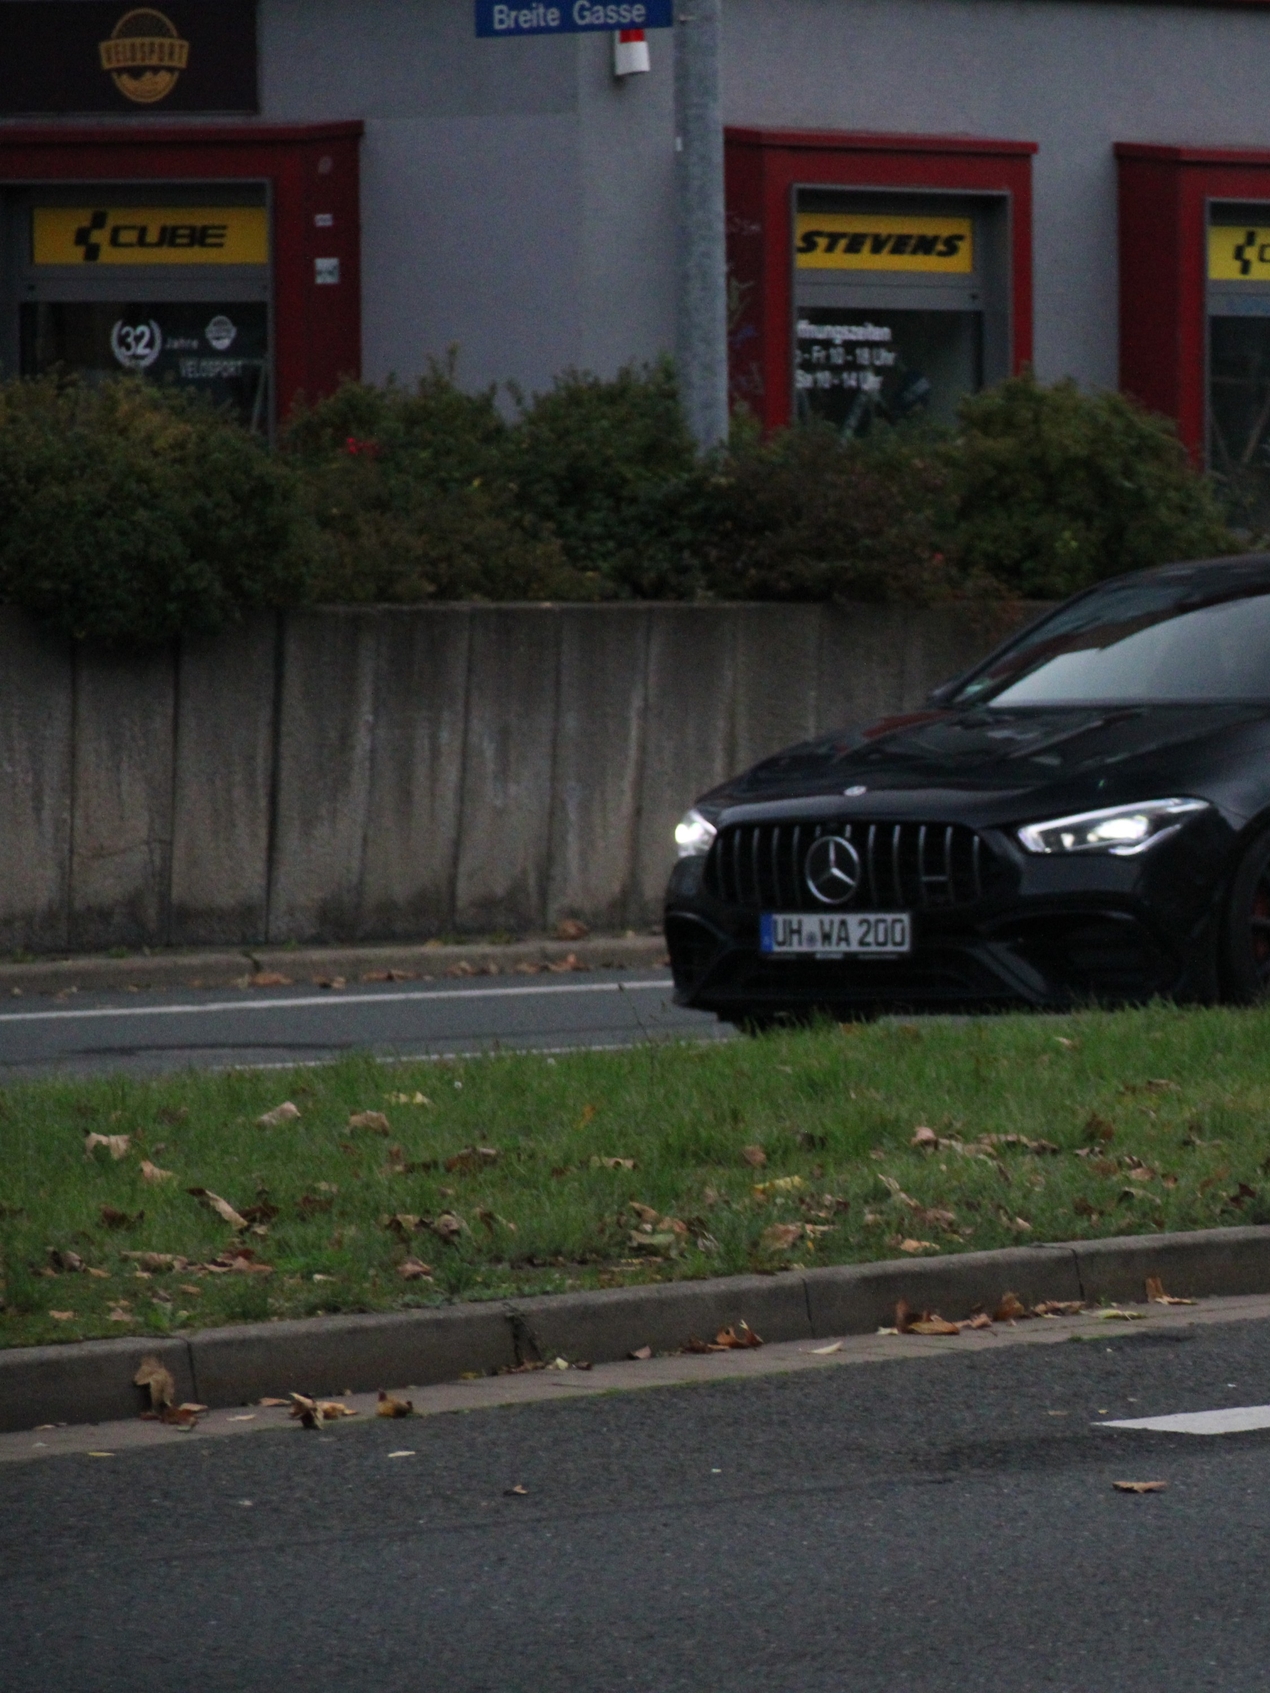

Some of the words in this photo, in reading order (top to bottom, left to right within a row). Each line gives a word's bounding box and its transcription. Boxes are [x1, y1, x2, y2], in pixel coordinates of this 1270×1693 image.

[493, 4, 560, 30] Breite
[572, 0, 646, 25] Gasse
[104, 41, 187, 65] VELOSPORT
[110, 225, 227, 248] CUBE
[797, 231, 965, 257] STEVENS
[120, 325, 151, 356] 32
[775, 919, 803, 947] UH
[820, 919, 851, 947] WA
[859, 919, 906, 947] 200
